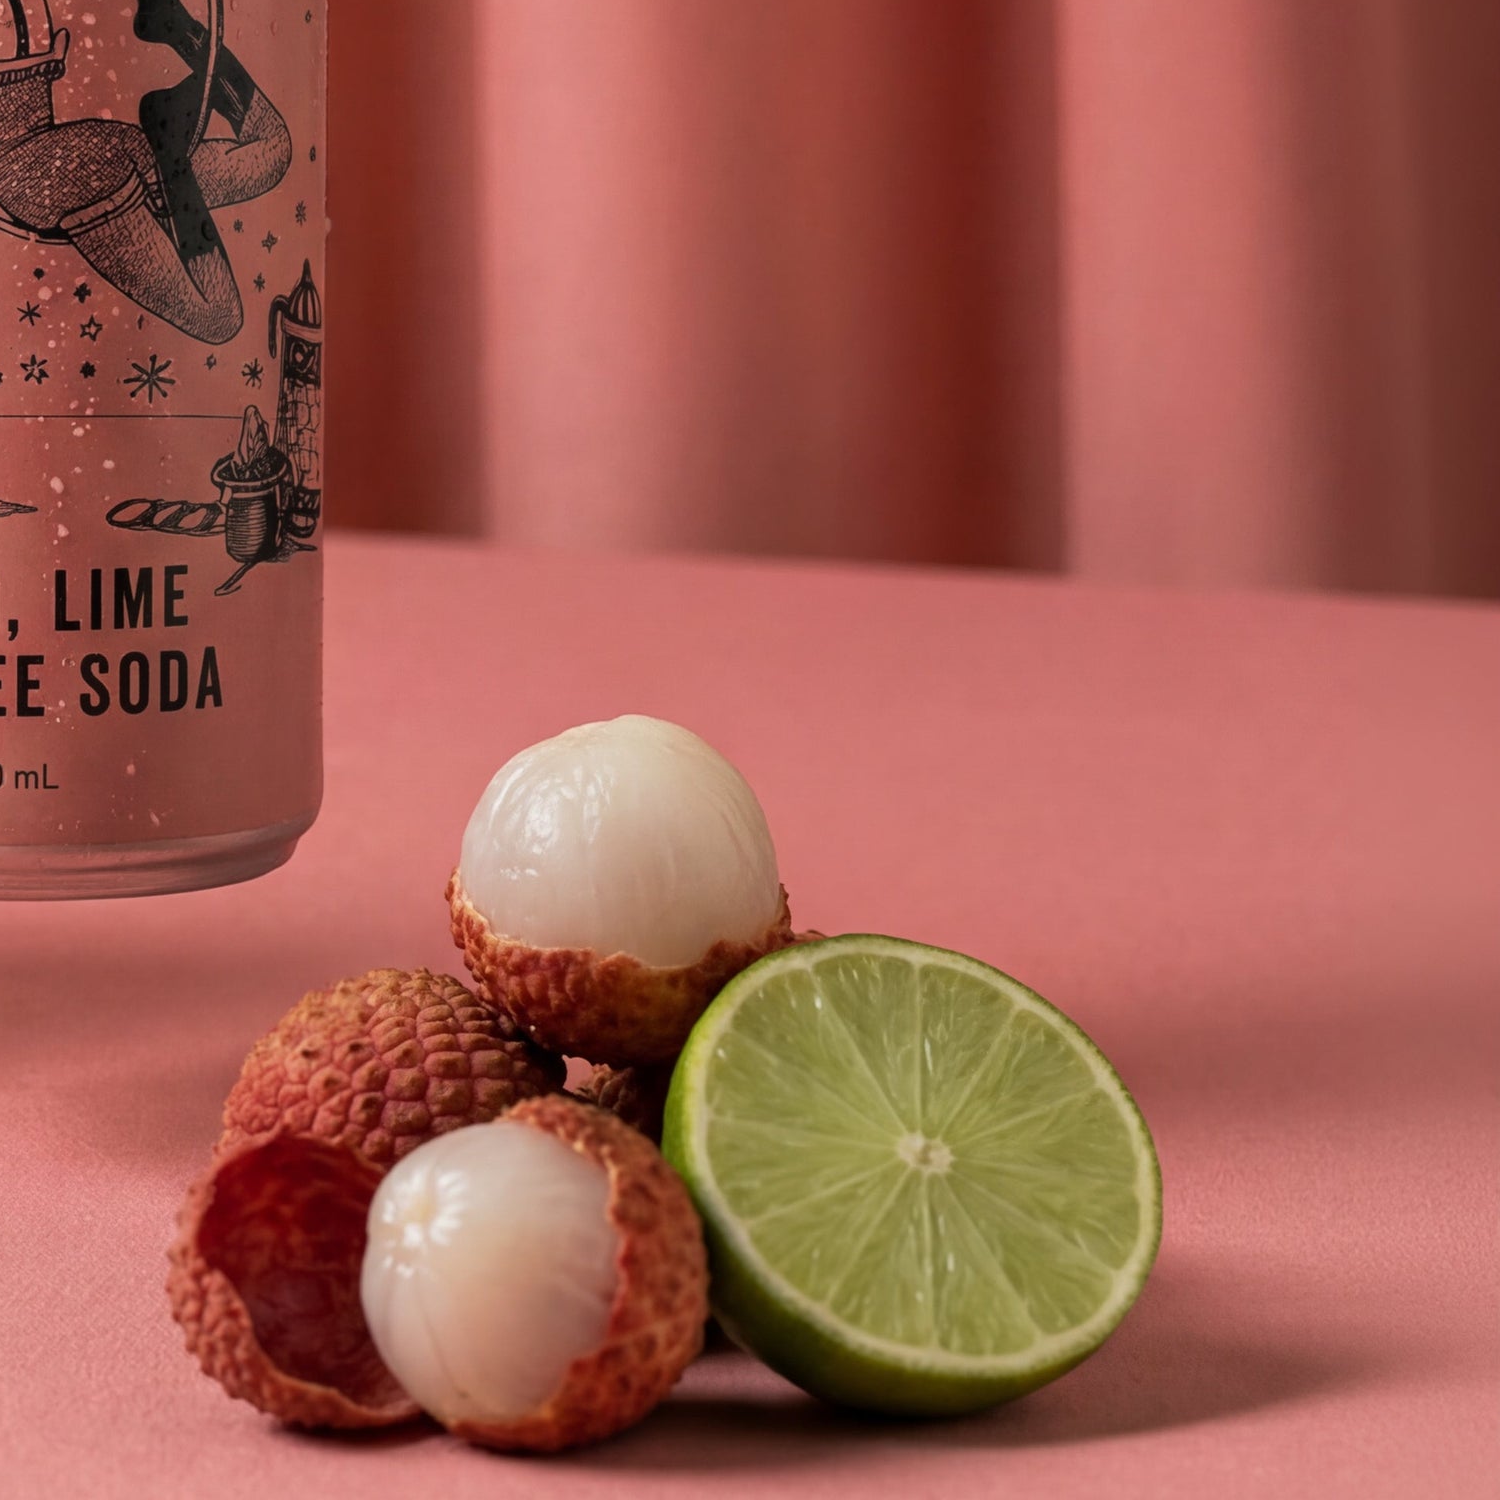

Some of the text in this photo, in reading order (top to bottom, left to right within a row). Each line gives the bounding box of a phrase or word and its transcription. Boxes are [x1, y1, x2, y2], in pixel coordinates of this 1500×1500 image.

[54, 565, 189, 632] LIME
[79, 645, 224, 717] SODA
[14, 763, 59, 791] mL
